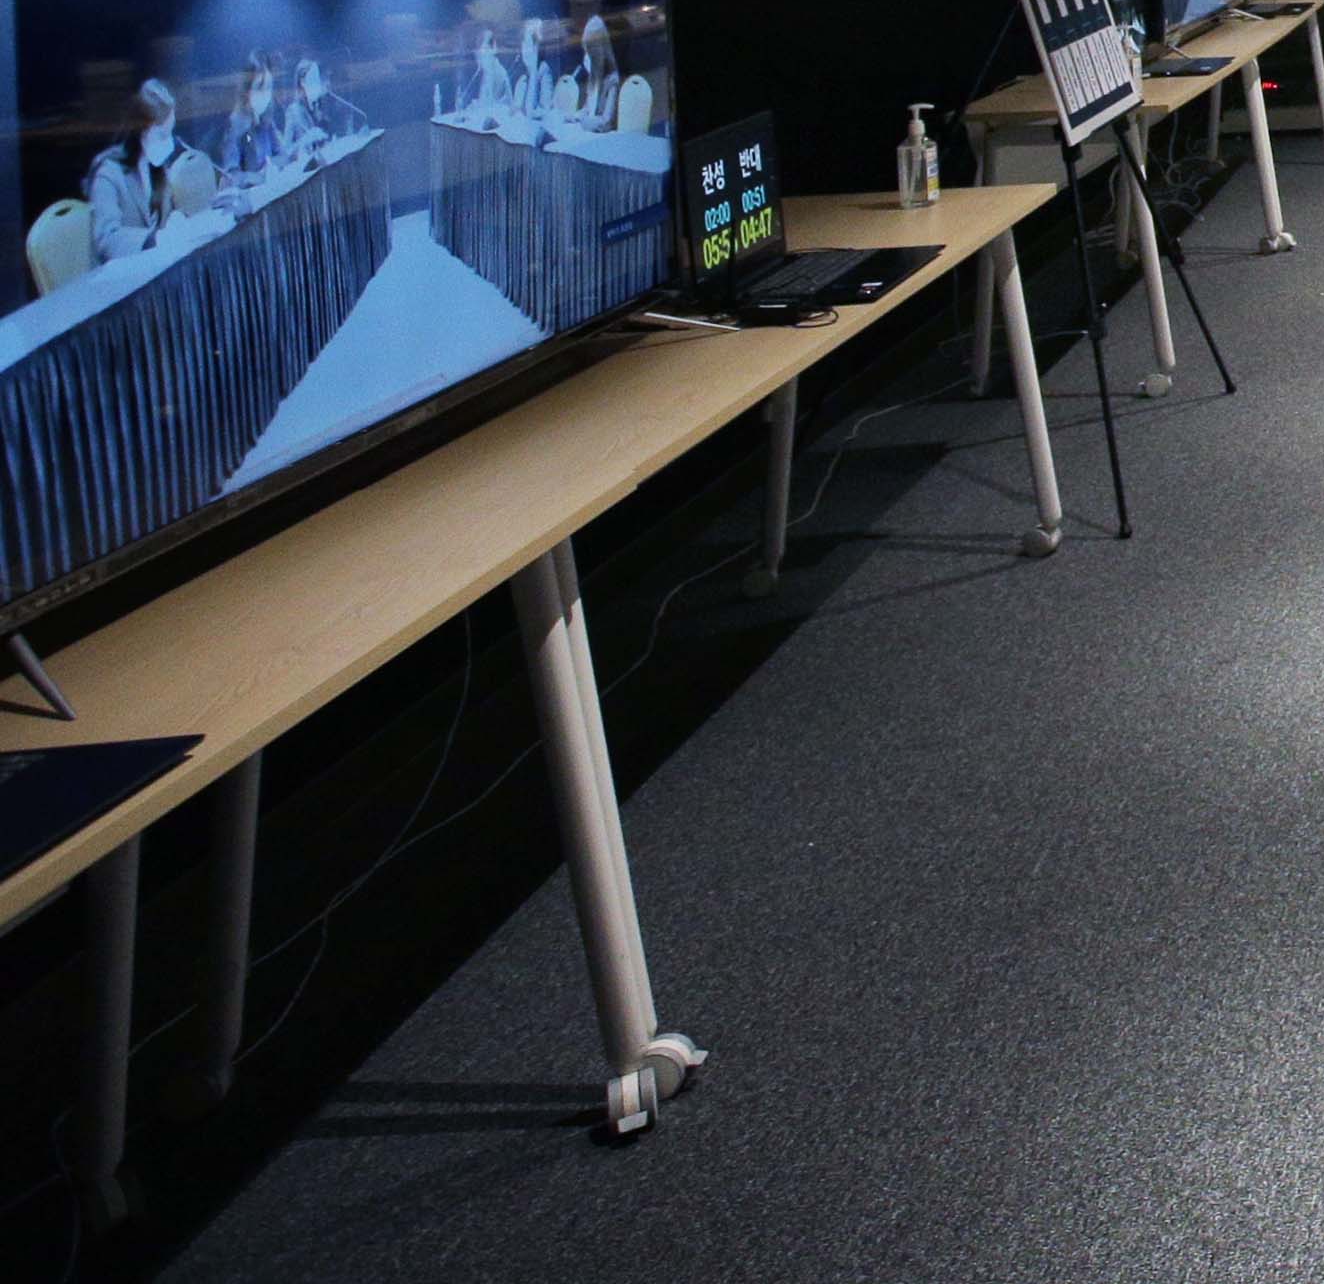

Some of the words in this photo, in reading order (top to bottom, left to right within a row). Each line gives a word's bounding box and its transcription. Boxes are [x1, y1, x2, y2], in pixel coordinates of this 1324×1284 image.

[701, 158, 726, 196] 찬성
[738, 143, 763, 179] 반대
[702, 226, 739, 269] 05:5
[740, 206, 773, 249] 04:47
[704, 200, 732, 232] 02:00
